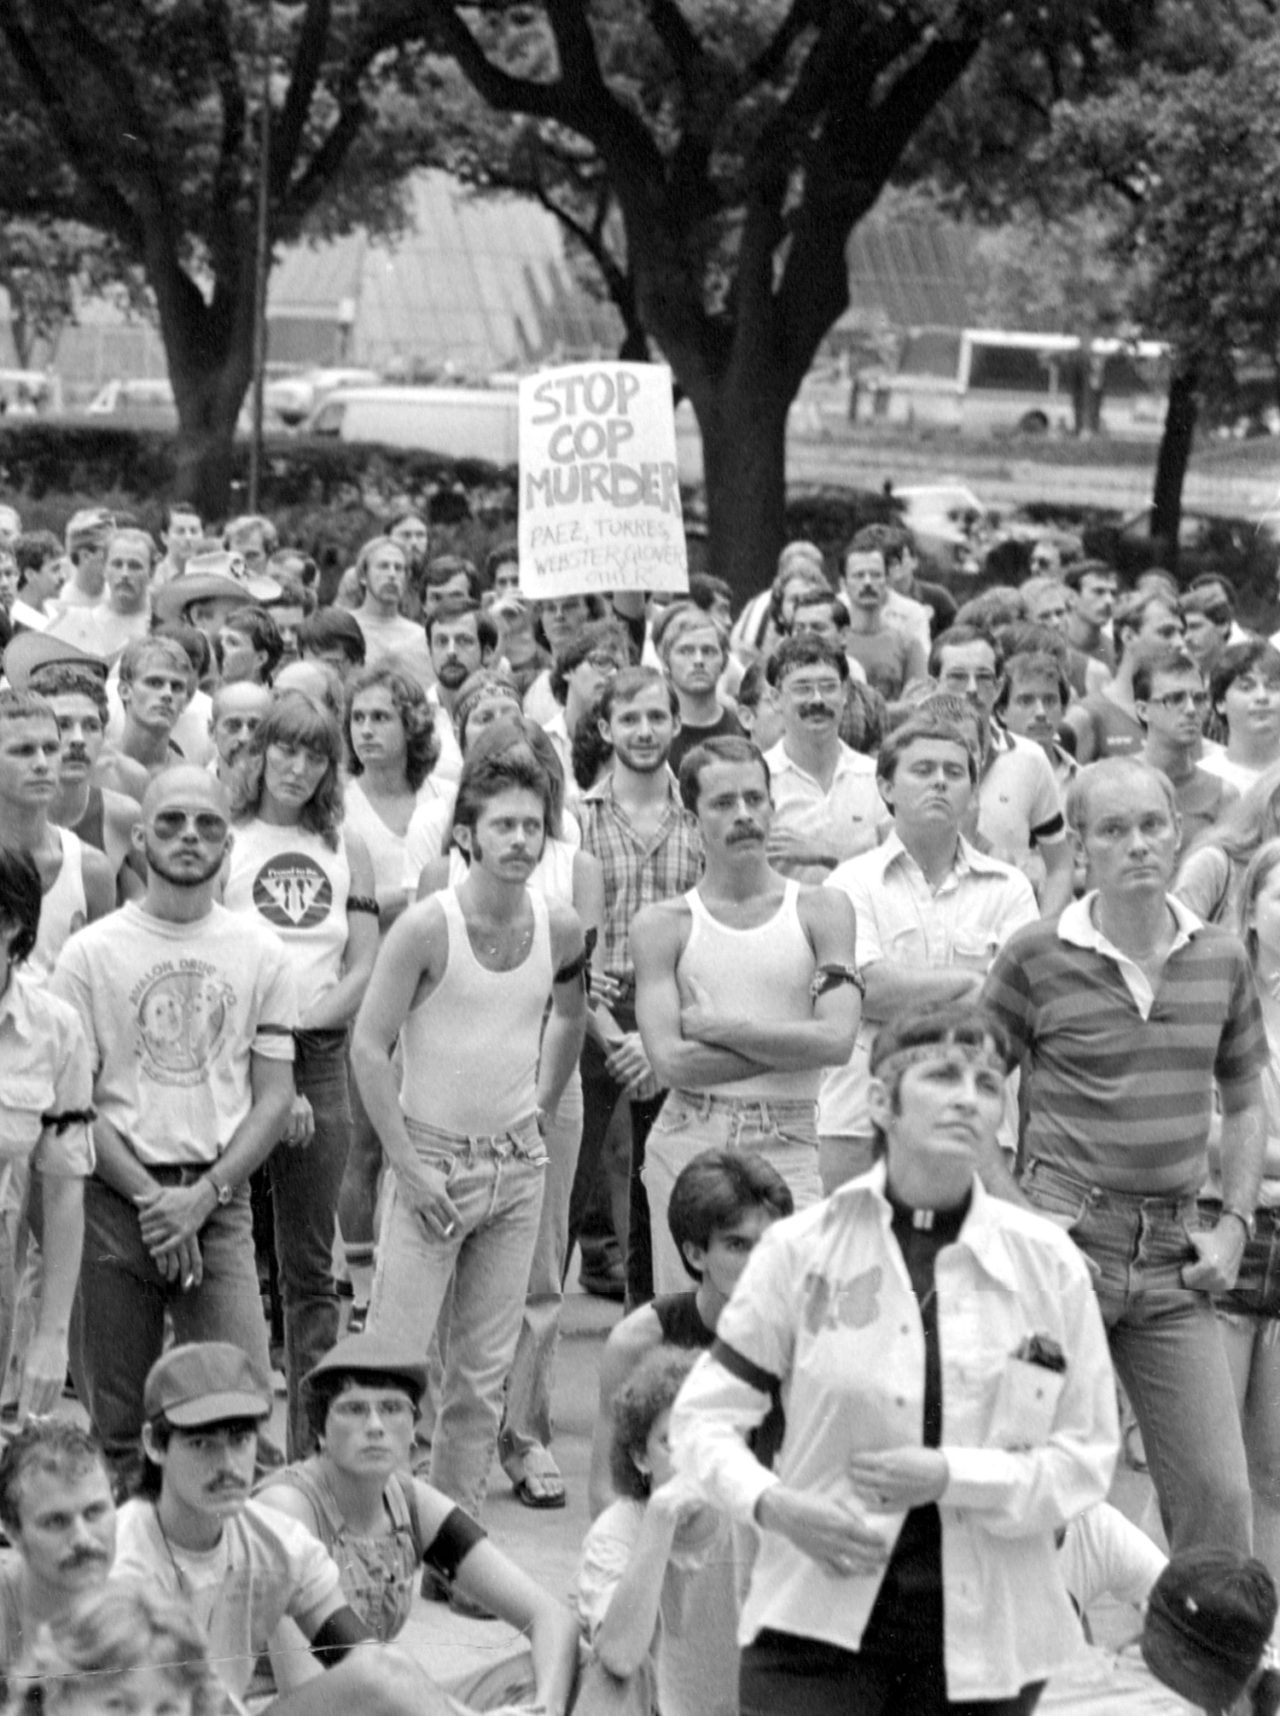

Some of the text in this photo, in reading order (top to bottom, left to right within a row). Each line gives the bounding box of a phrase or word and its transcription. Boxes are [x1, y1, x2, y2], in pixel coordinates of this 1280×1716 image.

[531, 371, 640, 425] STOP
[548, 418, 634, 463] COP
[526, 461, 681, 519] MURDER
